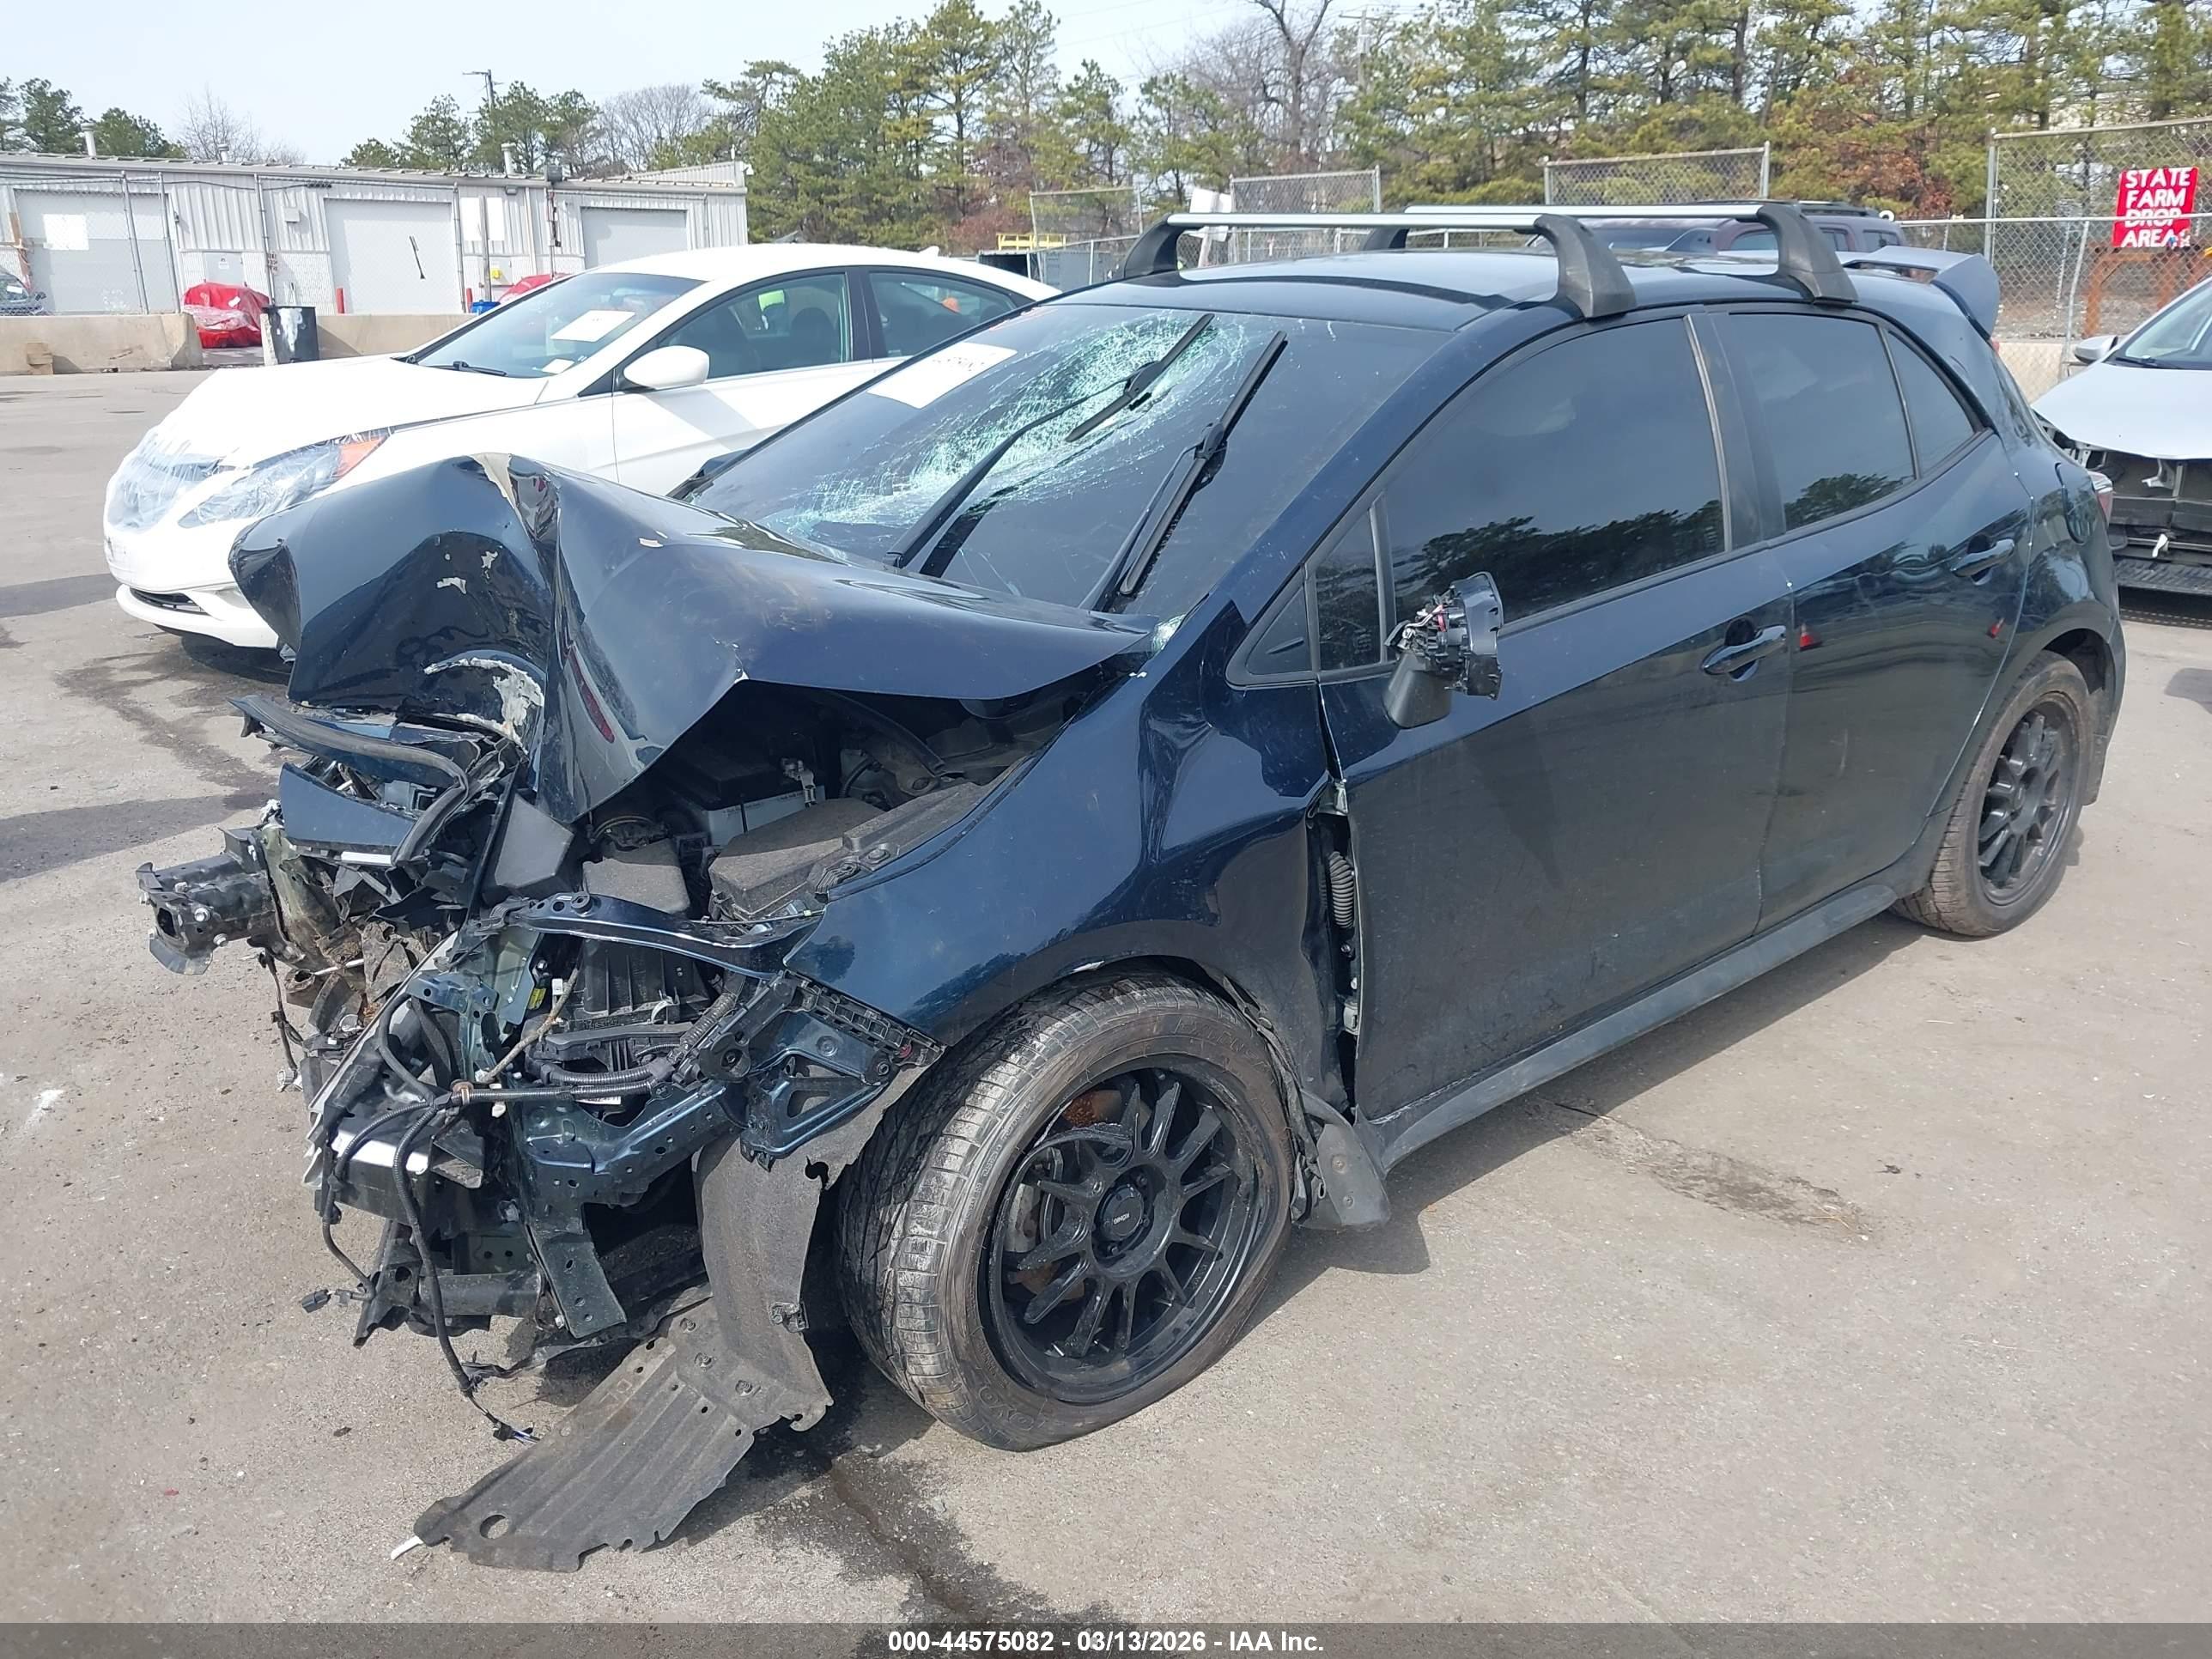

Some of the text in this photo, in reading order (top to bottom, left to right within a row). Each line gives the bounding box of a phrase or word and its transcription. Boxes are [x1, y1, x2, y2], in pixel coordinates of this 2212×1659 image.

[2125, 167, 2191, 188] STATE
[2125, 188, 2187, 208] FARM
[2124, 208, 2182, 228] DROP
